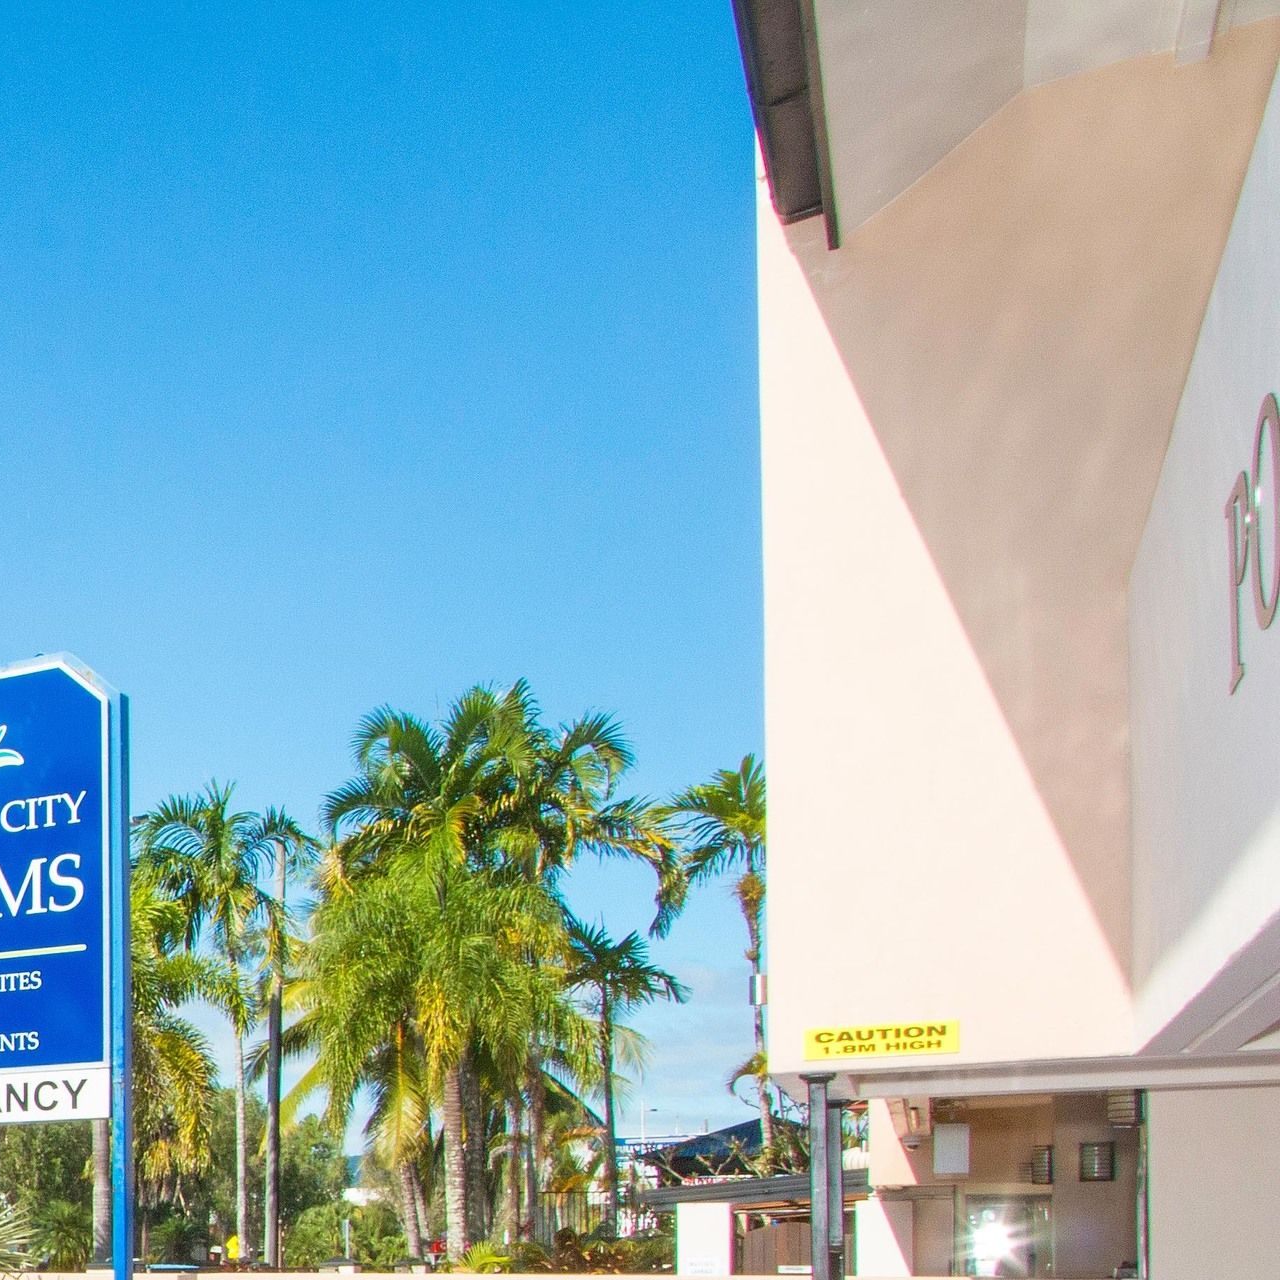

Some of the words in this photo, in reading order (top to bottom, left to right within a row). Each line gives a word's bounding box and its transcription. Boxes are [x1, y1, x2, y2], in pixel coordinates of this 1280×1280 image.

[0, 790, 88, 833] CITY
[814, 1024, 947, 1043] CAUTION
[822, 1044, 876, 1055] 1.8M
[885, 1039, 942, 1052] HIGH
